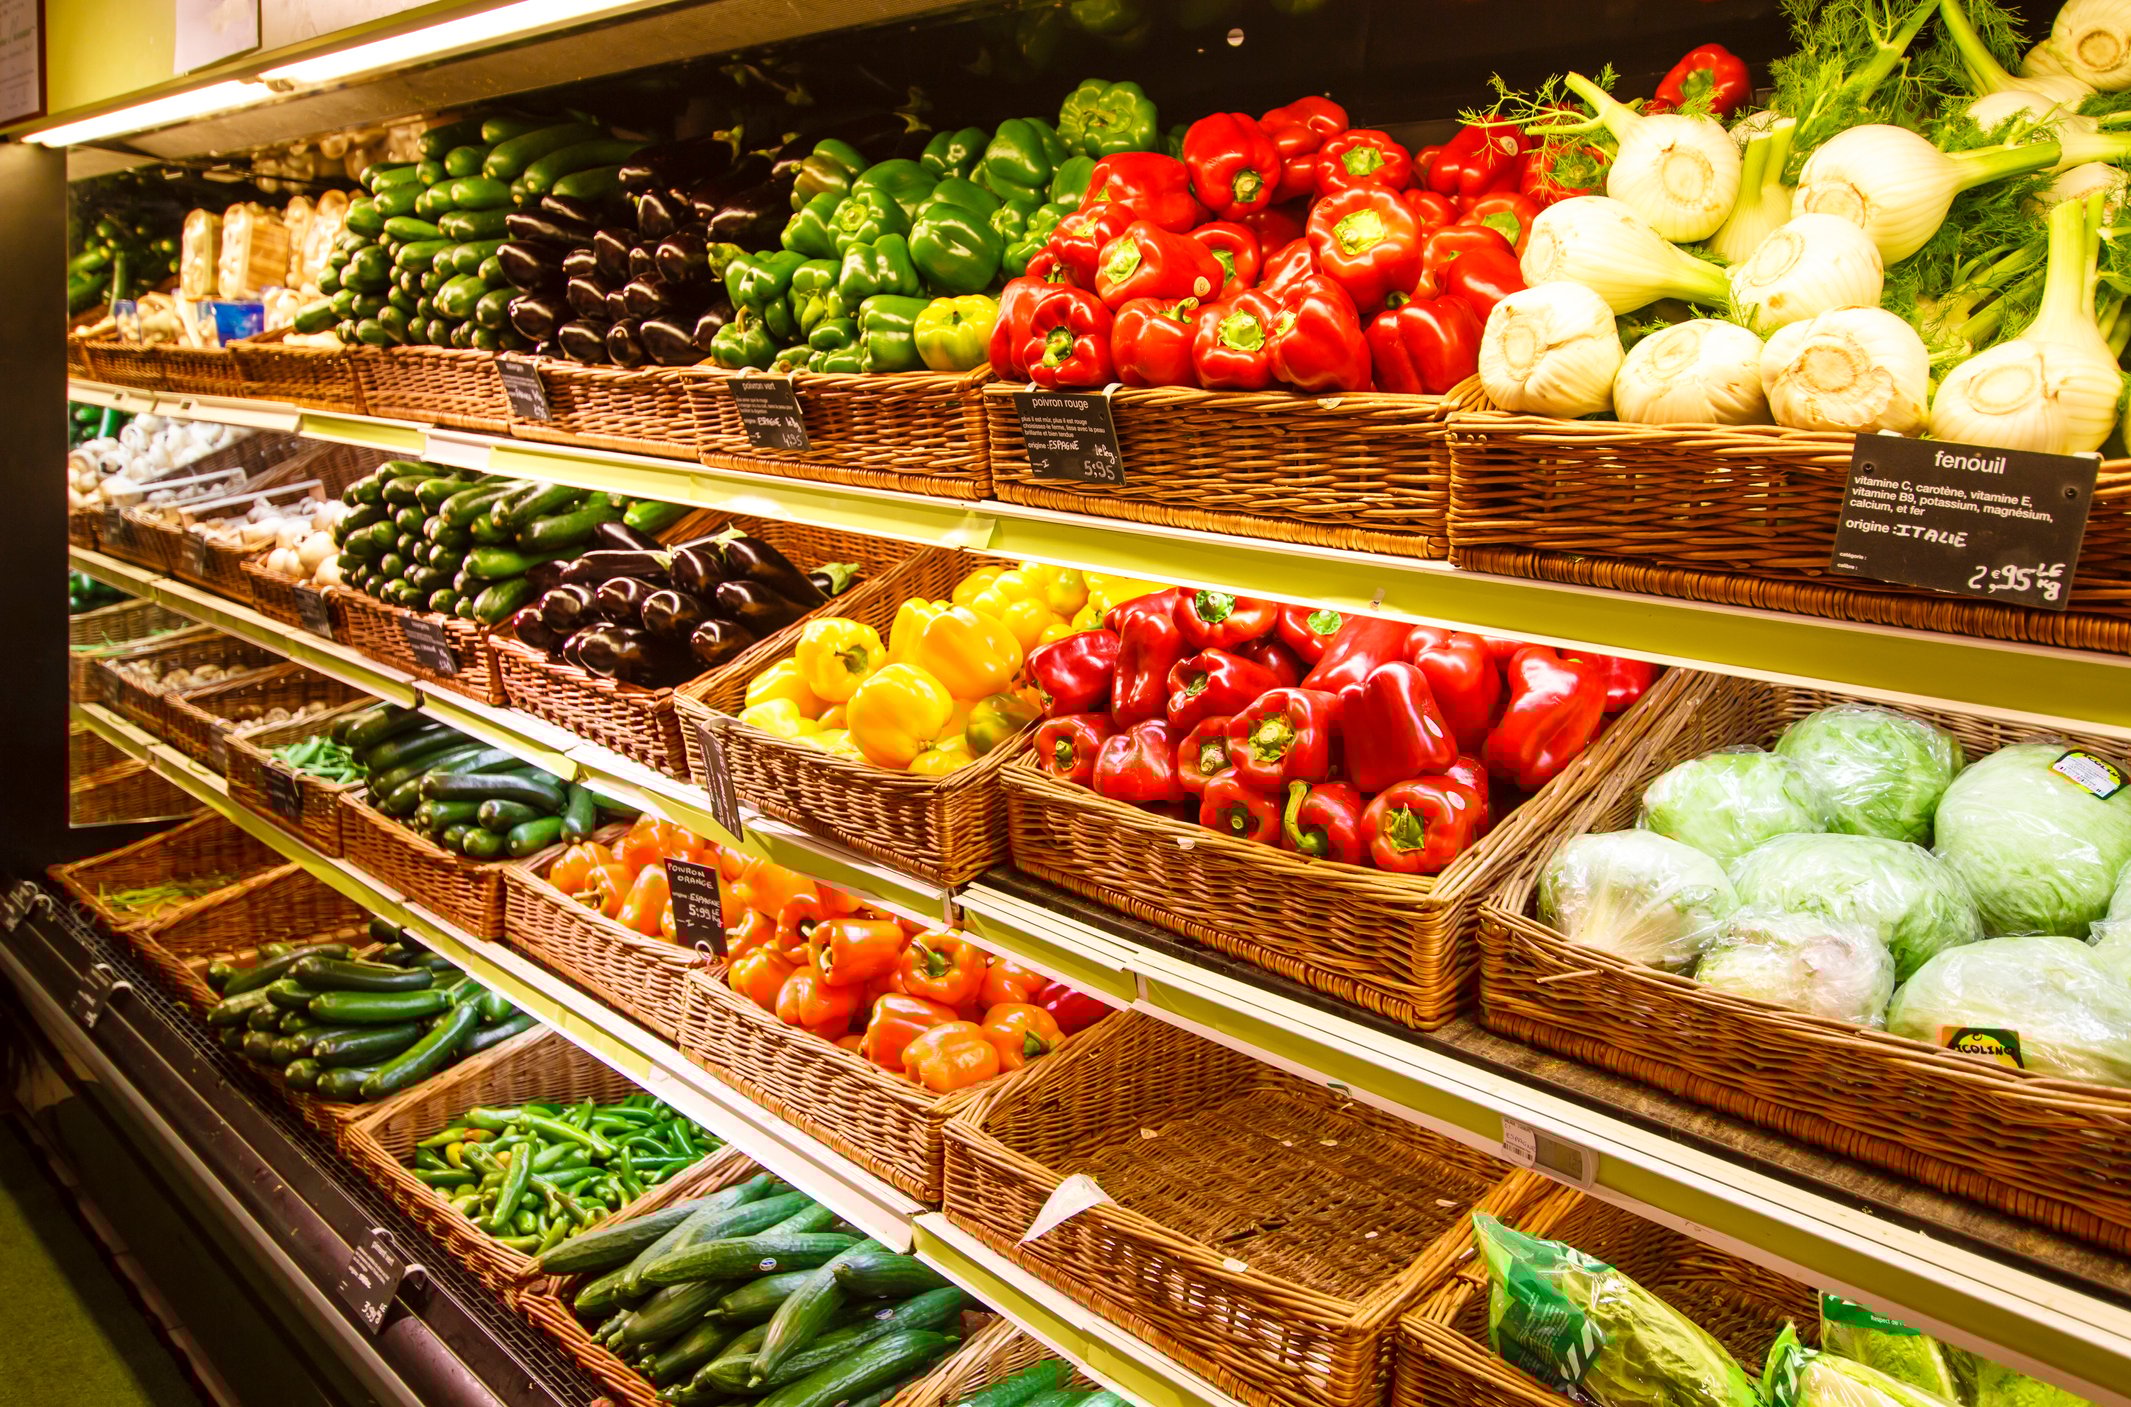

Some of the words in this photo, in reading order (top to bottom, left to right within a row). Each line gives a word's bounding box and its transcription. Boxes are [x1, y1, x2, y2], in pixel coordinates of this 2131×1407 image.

[1032, 396, 1063, 408] poivron
[1064, 399, 1089, 411] rouge
[1934, 450, 2007, 475] fenouil
[1854, 475, 1899, 490] vitamine
[1901, 480, 1914, 492] C,
[1915, 482, 1968, 499] carotène,
[1970, 489, 2019, 505] vitamine
[2021, 496, 2033, 509] E,
[1850, 498, 1894, 514] calcium,
[1896, 504, 1907, 514] et
[1909, 505, 1926, 516] fer
[1852, 487, 1897, 501] vitamine
[1898, 492, 1917, 504] B9,
[1919, 496, 1981, 514] potassium,
[1983, 503, 2053, 523] magnésium,
[1845, 518, 1890, 534] origine
[677, 875, 714, 890] ORANGE
